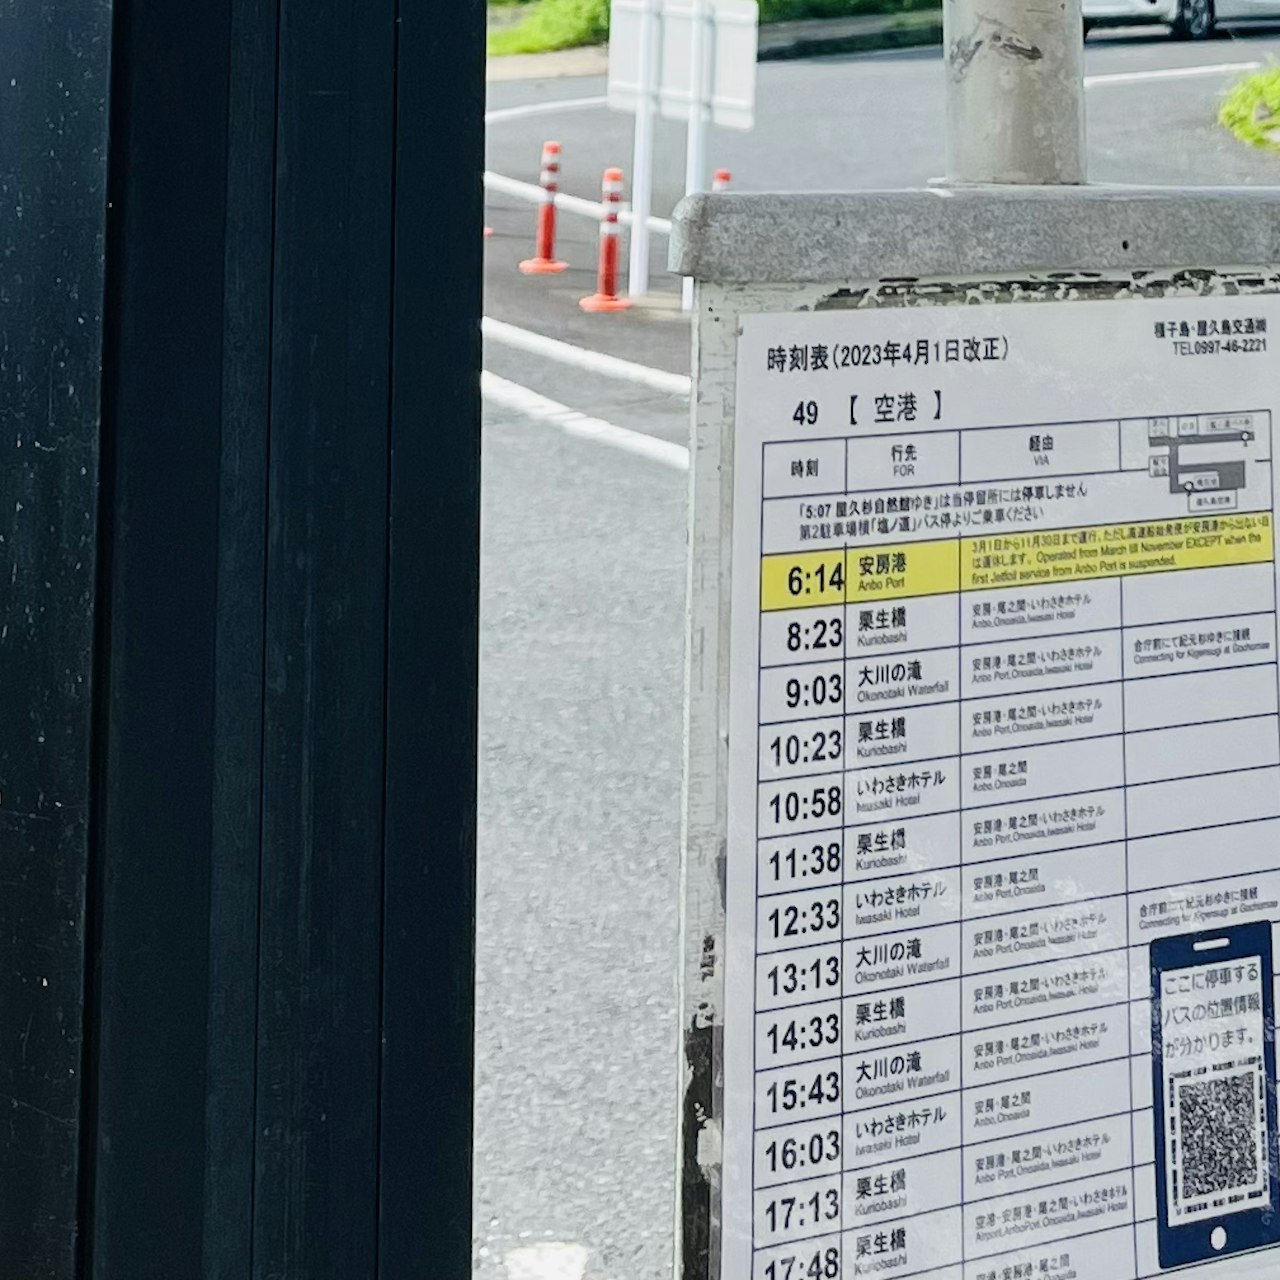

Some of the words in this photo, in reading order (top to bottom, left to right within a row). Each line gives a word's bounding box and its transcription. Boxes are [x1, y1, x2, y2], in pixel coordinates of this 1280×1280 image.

[793, 400, 818, 425] 49
[890, 443, 917, 462] 行先
[1029, 433, 1054, 452] 経由
[1034, 454, 1050, 466] VIA
[791, 458, 819, 478] 時刻
[893, 464, 915, 477] FOR
[788, 561, 844, 596] 6:14
[859, 552, 907, 575] 安房港
[858, 578, 883, 592] Anbo
[886, 576, 905, 589] Port
[787, 618, 842, 652] 8:23
[859, 607, 907, 632] 栗生橋
[786, 673, 842, 708] 9:03
[858, 659, 922, 687] 大川の滝
[770, 730, 841, 766] 10:23
[858, 716, 906, 743] 栗生橋
[770, 786, 841, 824] 10:58
[857, 769, 946, 797] いわさきホテル
[770, 842, 840, 881] 11:38
[857, 828, 906, 856] 栗生橋
[769, 899, 840, 939] 12:33
[856, 881, 947, 910] いわさきホテル
[768, 956, 840, 996] 13:13
[856, 938, 922, 968] 大川の滝
[1164, 962, 1259, 994] ここに停車する
[767, 1013, 840, 1054] 14:33
[856, 996, 905, 1025] 栗生橋
[1165, 992, 1260, 1025] バスの位置情報
[767, 1071, 840, 1113] 15:43
[856, 1051, 922, 1083] 大川の滝
[765, 1130, 840, 1172] 16:03
[856, 1106, 947, 1139] いわさきホテル
[766, 1188, 839, 1232] 17:13
[856, 1168, 906, 1200] 栗生橋
[765, 1247, 839, 1280] 17:48
[856, 1227, 906, 1260] 栗生橋
